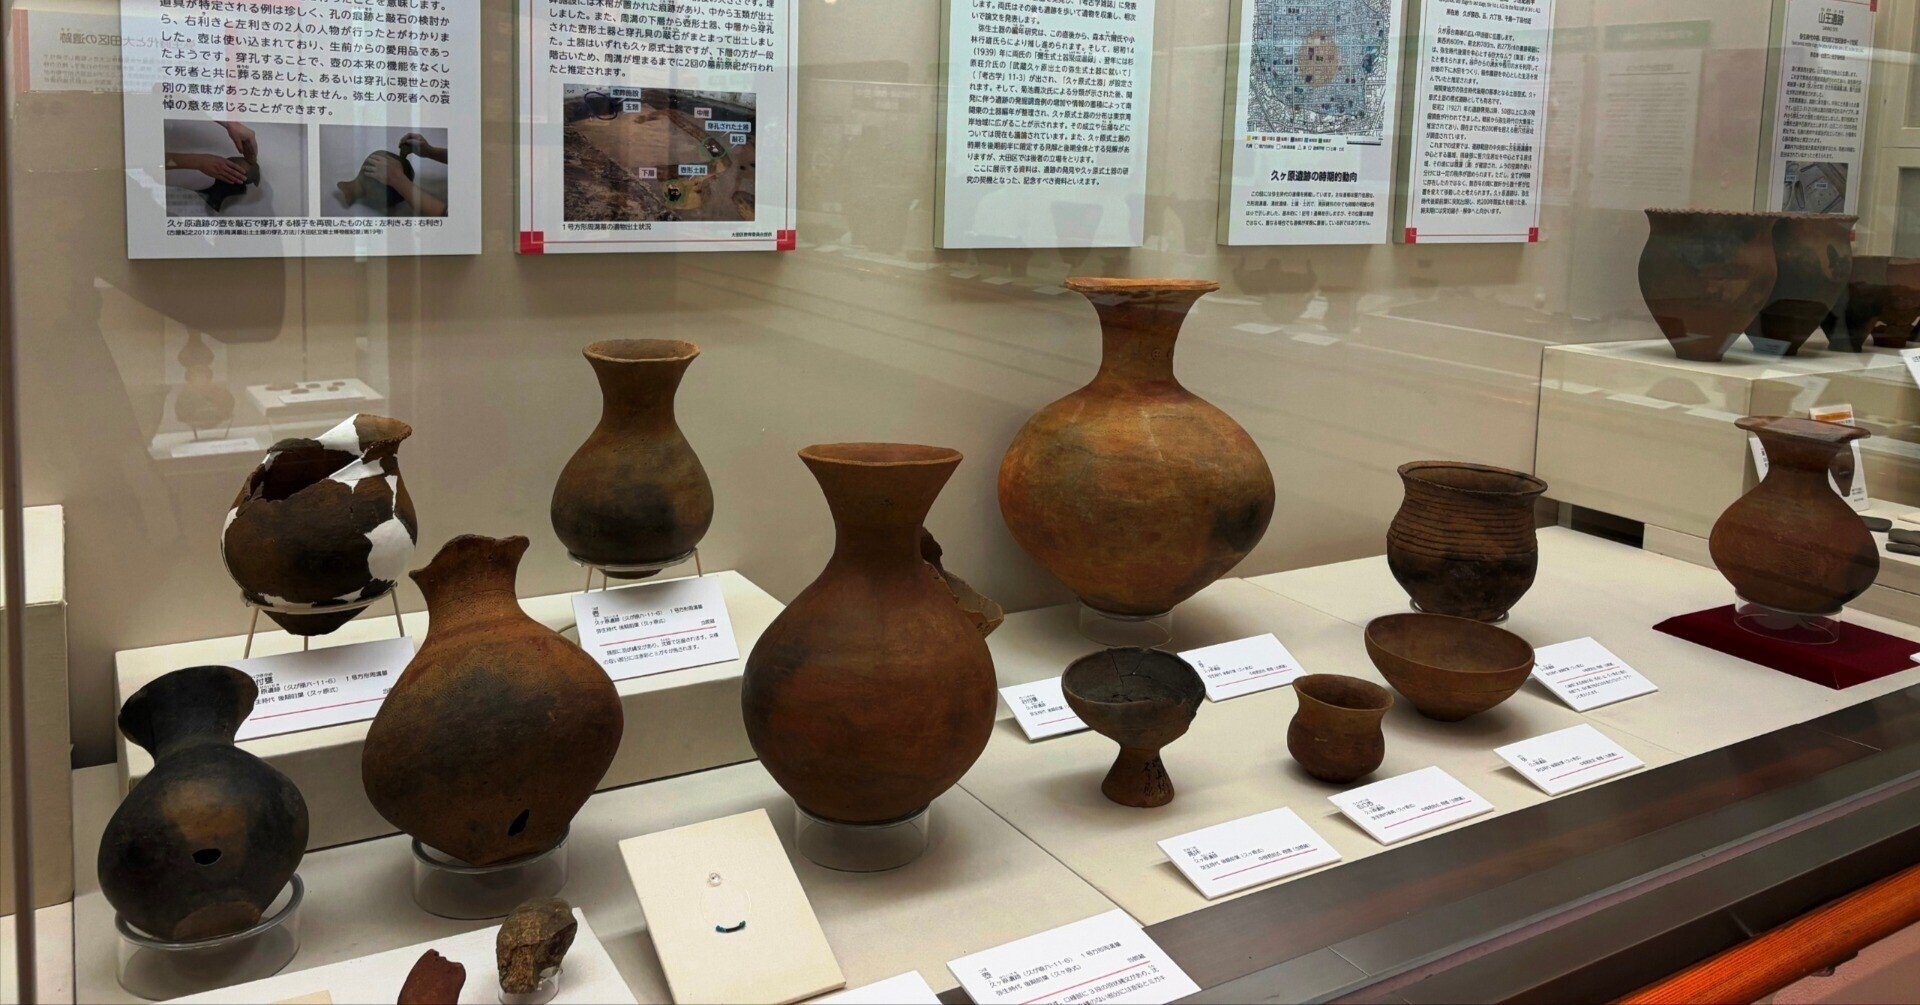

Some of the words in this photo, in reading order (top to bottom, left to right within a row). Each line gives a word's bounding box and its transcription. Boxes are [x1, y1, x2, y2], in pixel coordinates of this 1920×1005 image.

[550, 64, 626, 77] たと推定されます。
[162, 99, 333, 116] 悼の意を感じることができます。
[1270, 170, 1358, 182] 久ヶ原遺跡の時期的動向
[256, 677, 274, 685] 付甕
